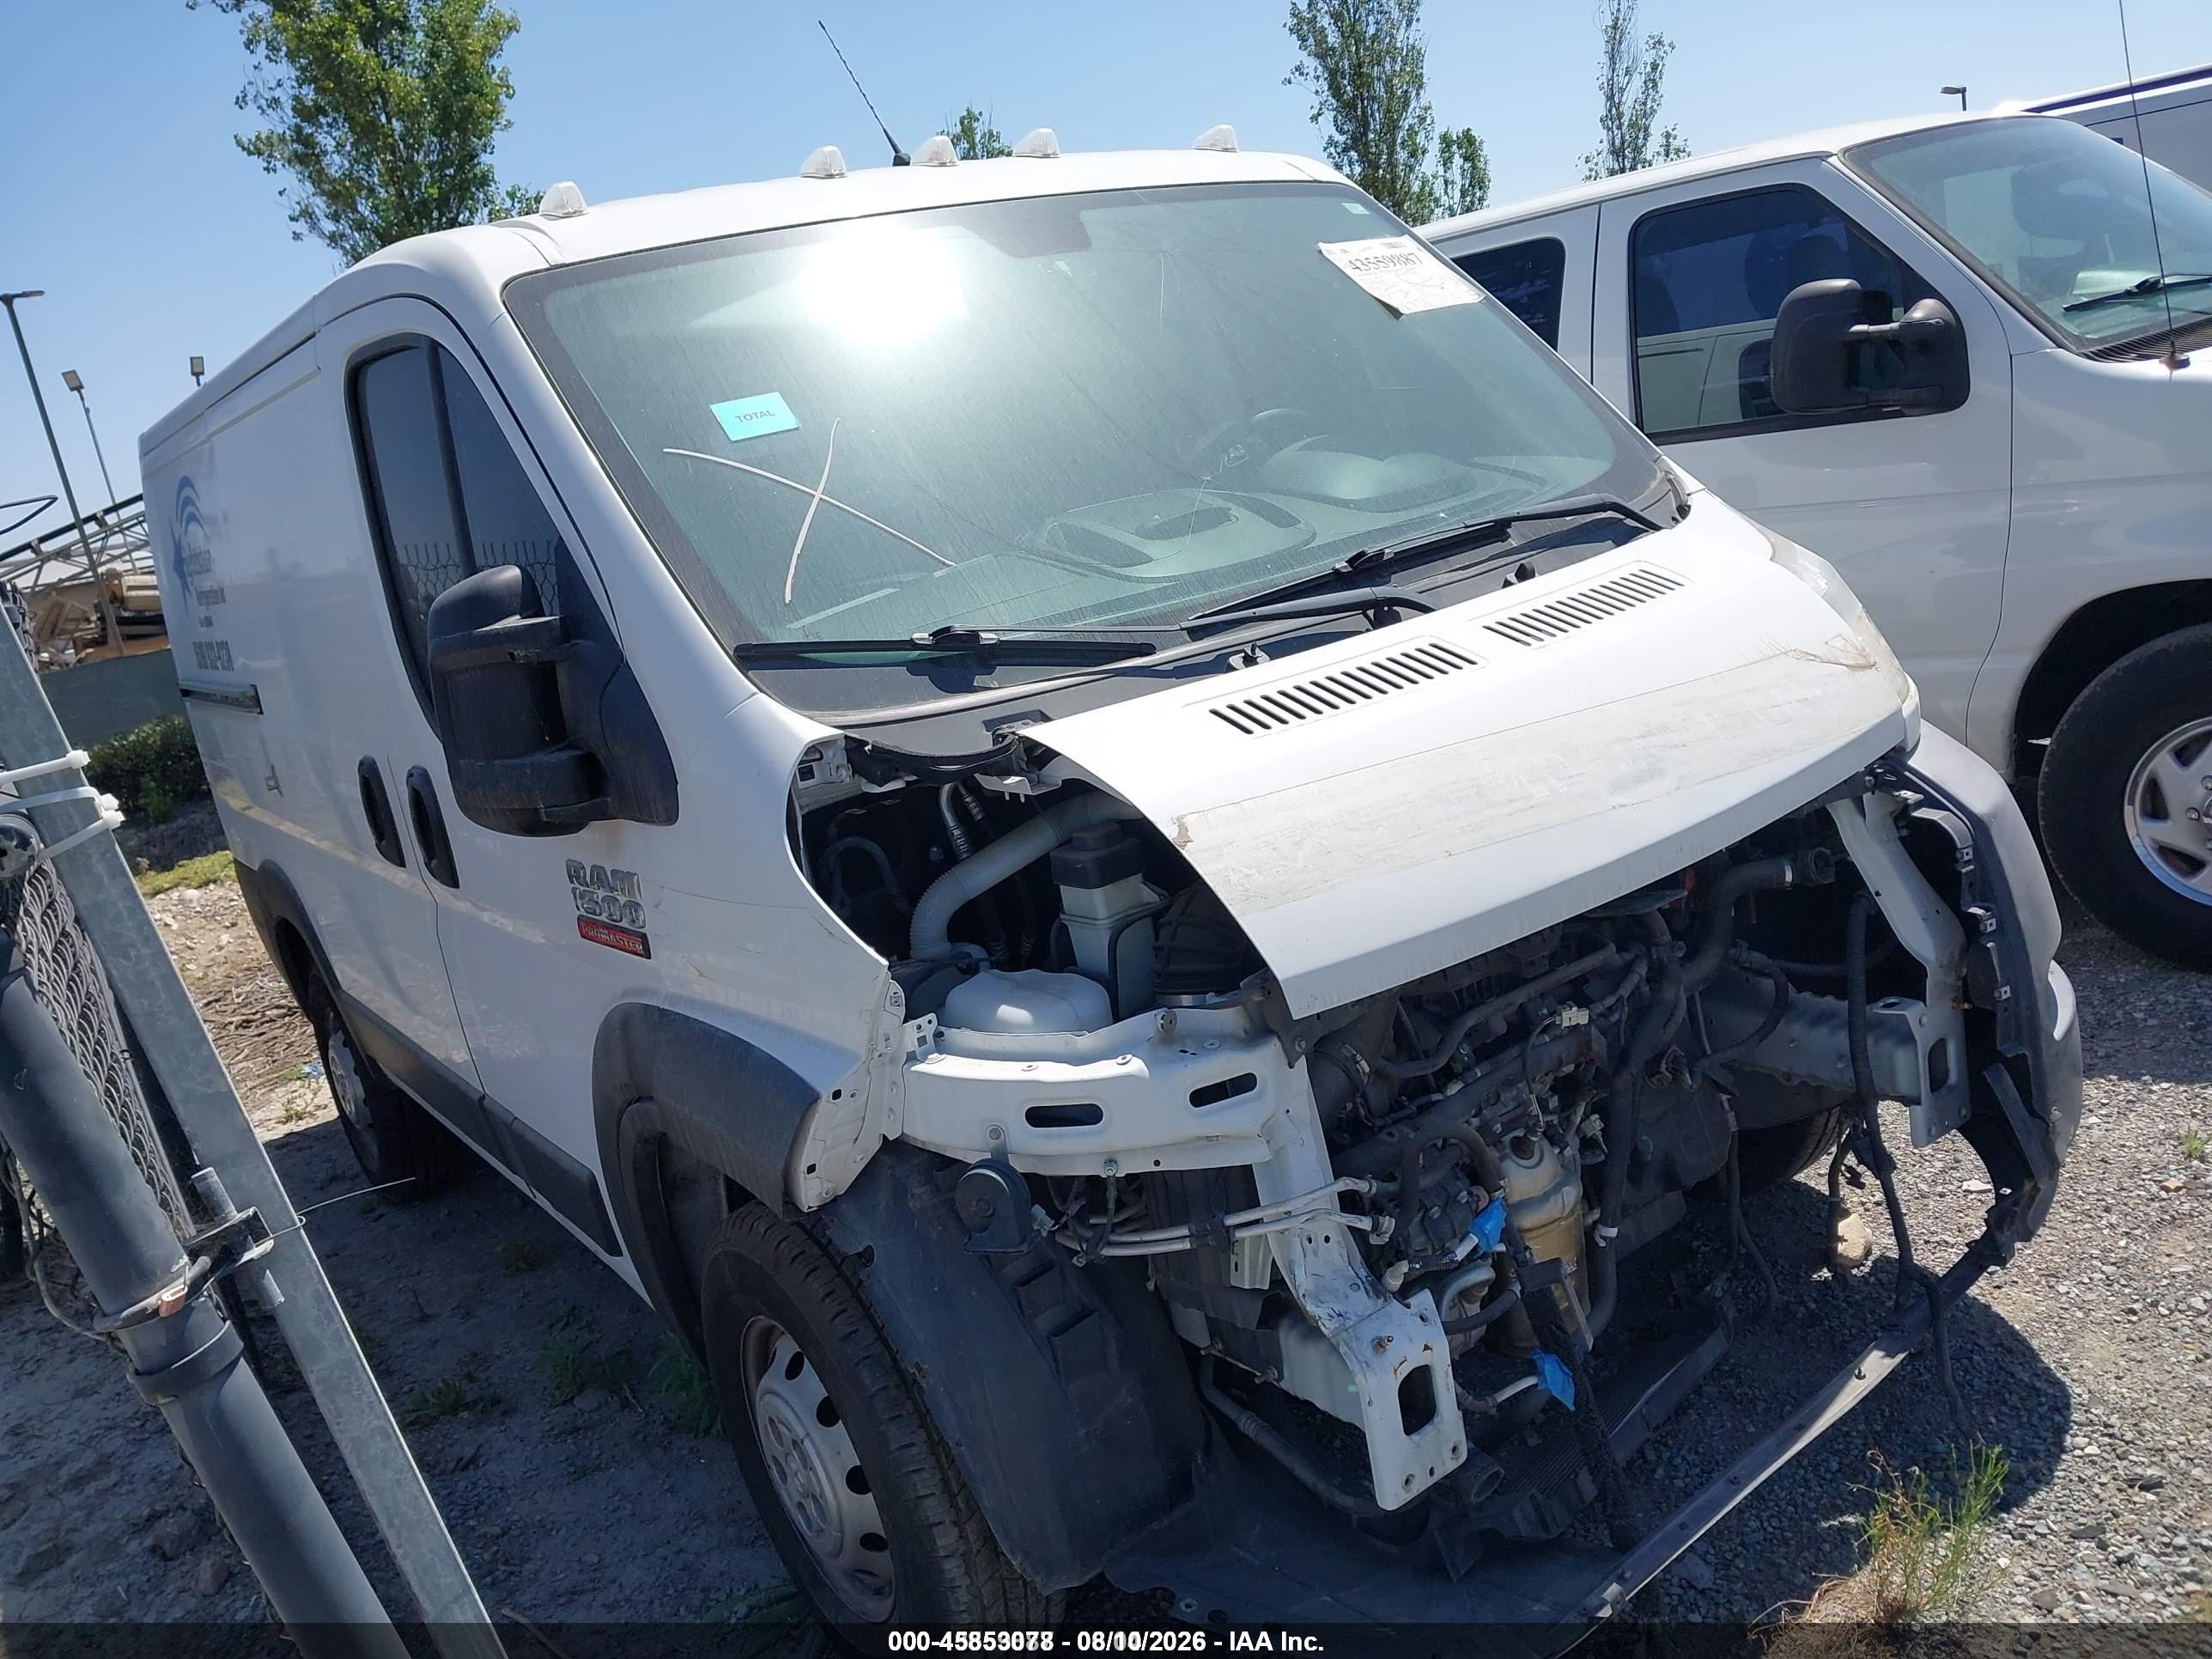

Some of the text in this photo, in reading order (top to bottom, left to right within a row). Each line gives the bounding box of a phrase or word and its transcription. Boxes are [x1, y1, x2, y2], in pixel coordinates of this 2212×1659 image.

[1347, 252, 1423, 272] 43559887
[735, 410, 775, 423] TOTAL
[565, 859, 642, 900] RAM
[571, 887, 647, 929] 1500
